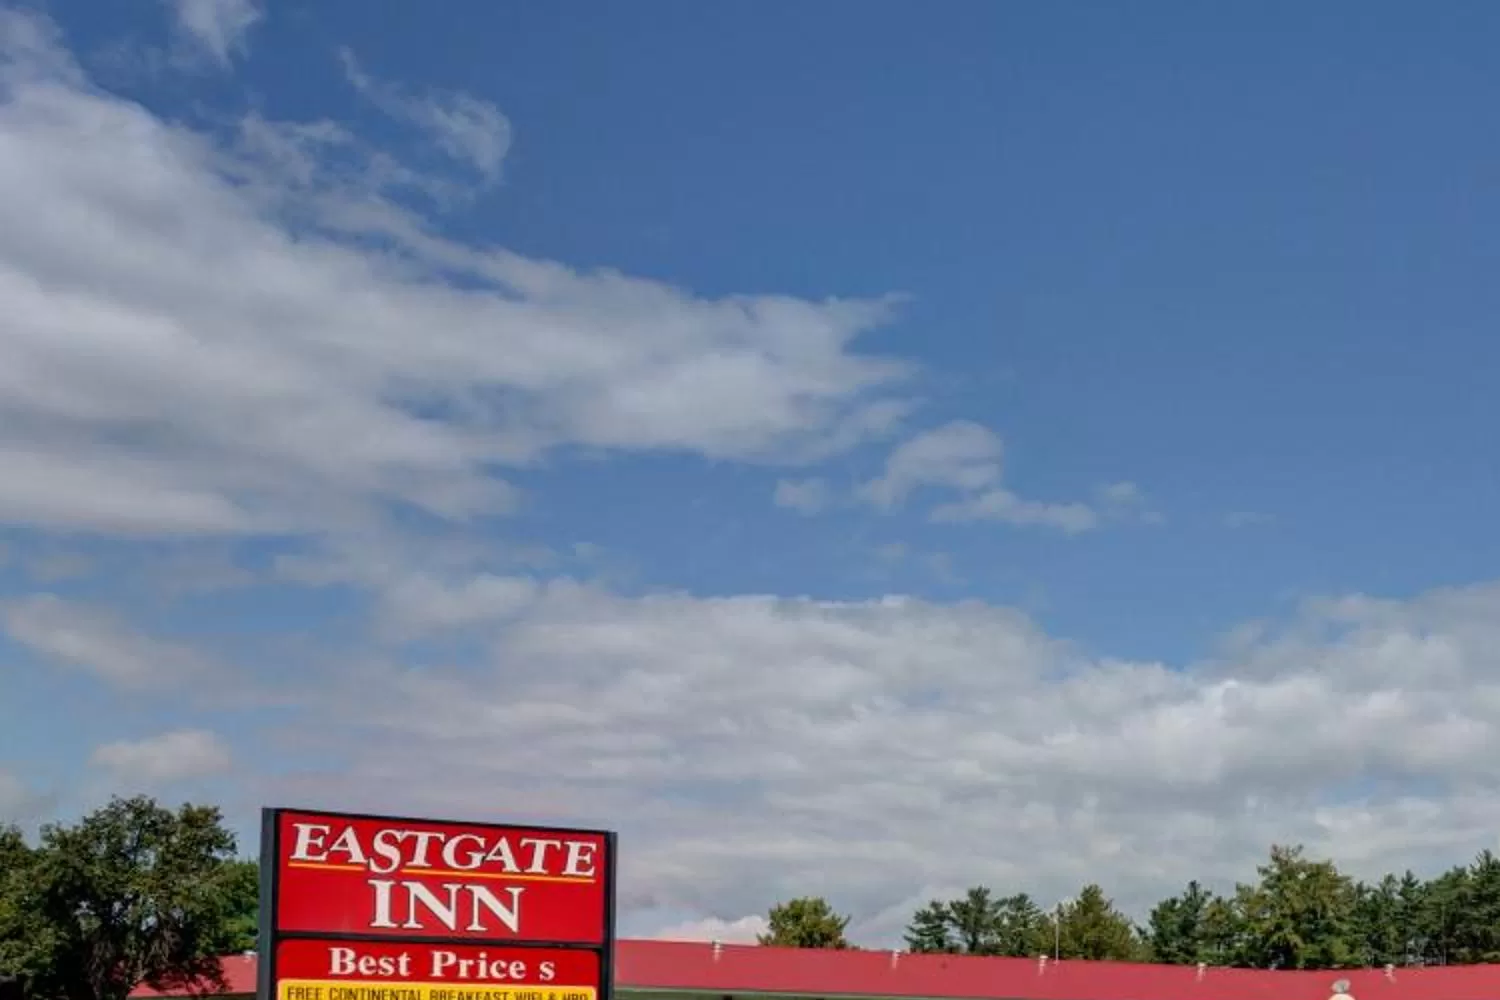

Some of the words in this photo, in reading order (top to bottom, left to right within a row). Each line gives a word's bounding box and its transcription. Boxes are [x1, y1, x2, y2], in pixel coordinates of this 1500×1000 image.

[290, 823, 597, 877] EASTGATE
[368, 880, 525, 933] INN
[328, 947, 411, 977] Best
[287, 987, 325, 1000] FREE
